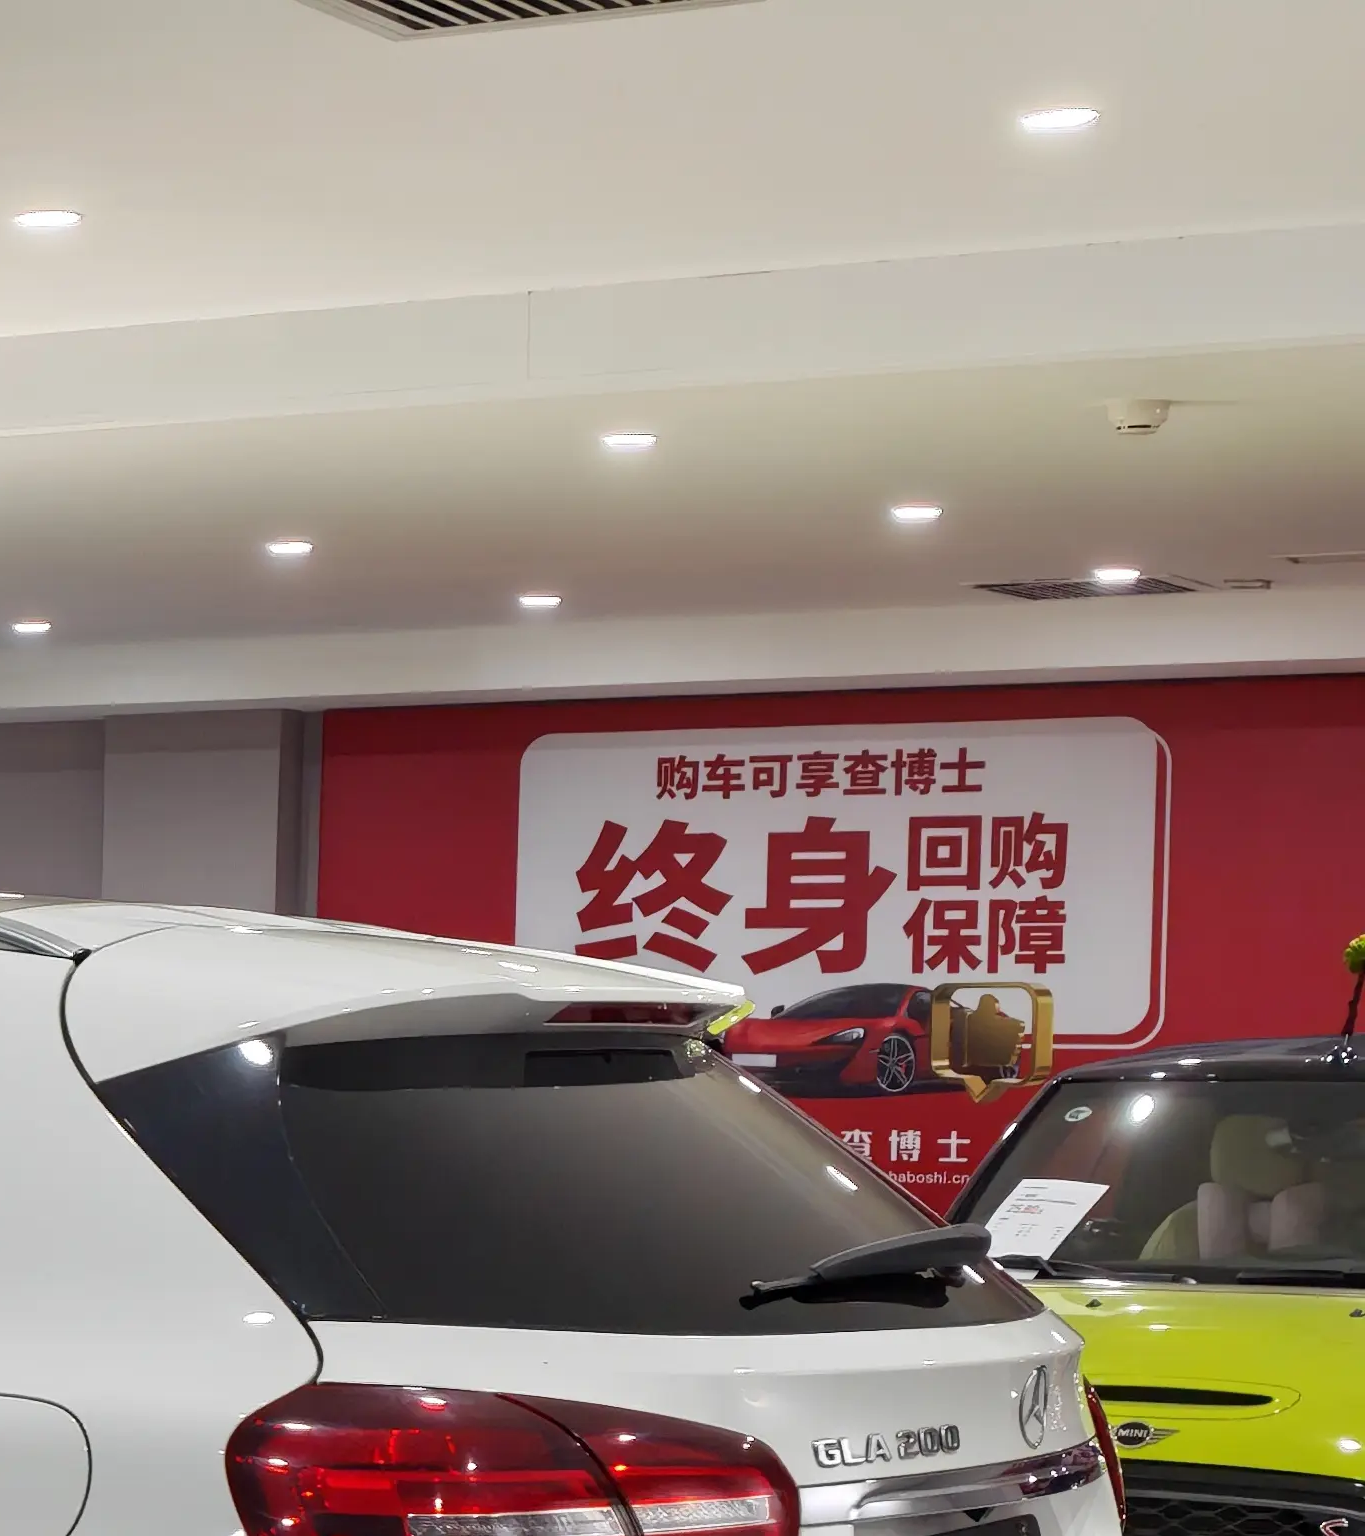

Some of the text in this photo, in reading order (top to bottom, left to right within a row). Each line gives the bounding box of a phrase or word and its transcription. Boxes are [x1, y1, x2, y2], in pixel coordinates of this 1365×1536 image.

[656, 747, 987, 800] 购车可享查博士
[906, 812, 1069, 892] 回购
[575, 815, 898, 974] 终身
[902, 896, 1066, 975] 保障
[840, 1128, 972, 1163] 查博士
[811, 1423, 961, 1468] GLA 200
[1117, 1428, 1149, 1438] MINI
